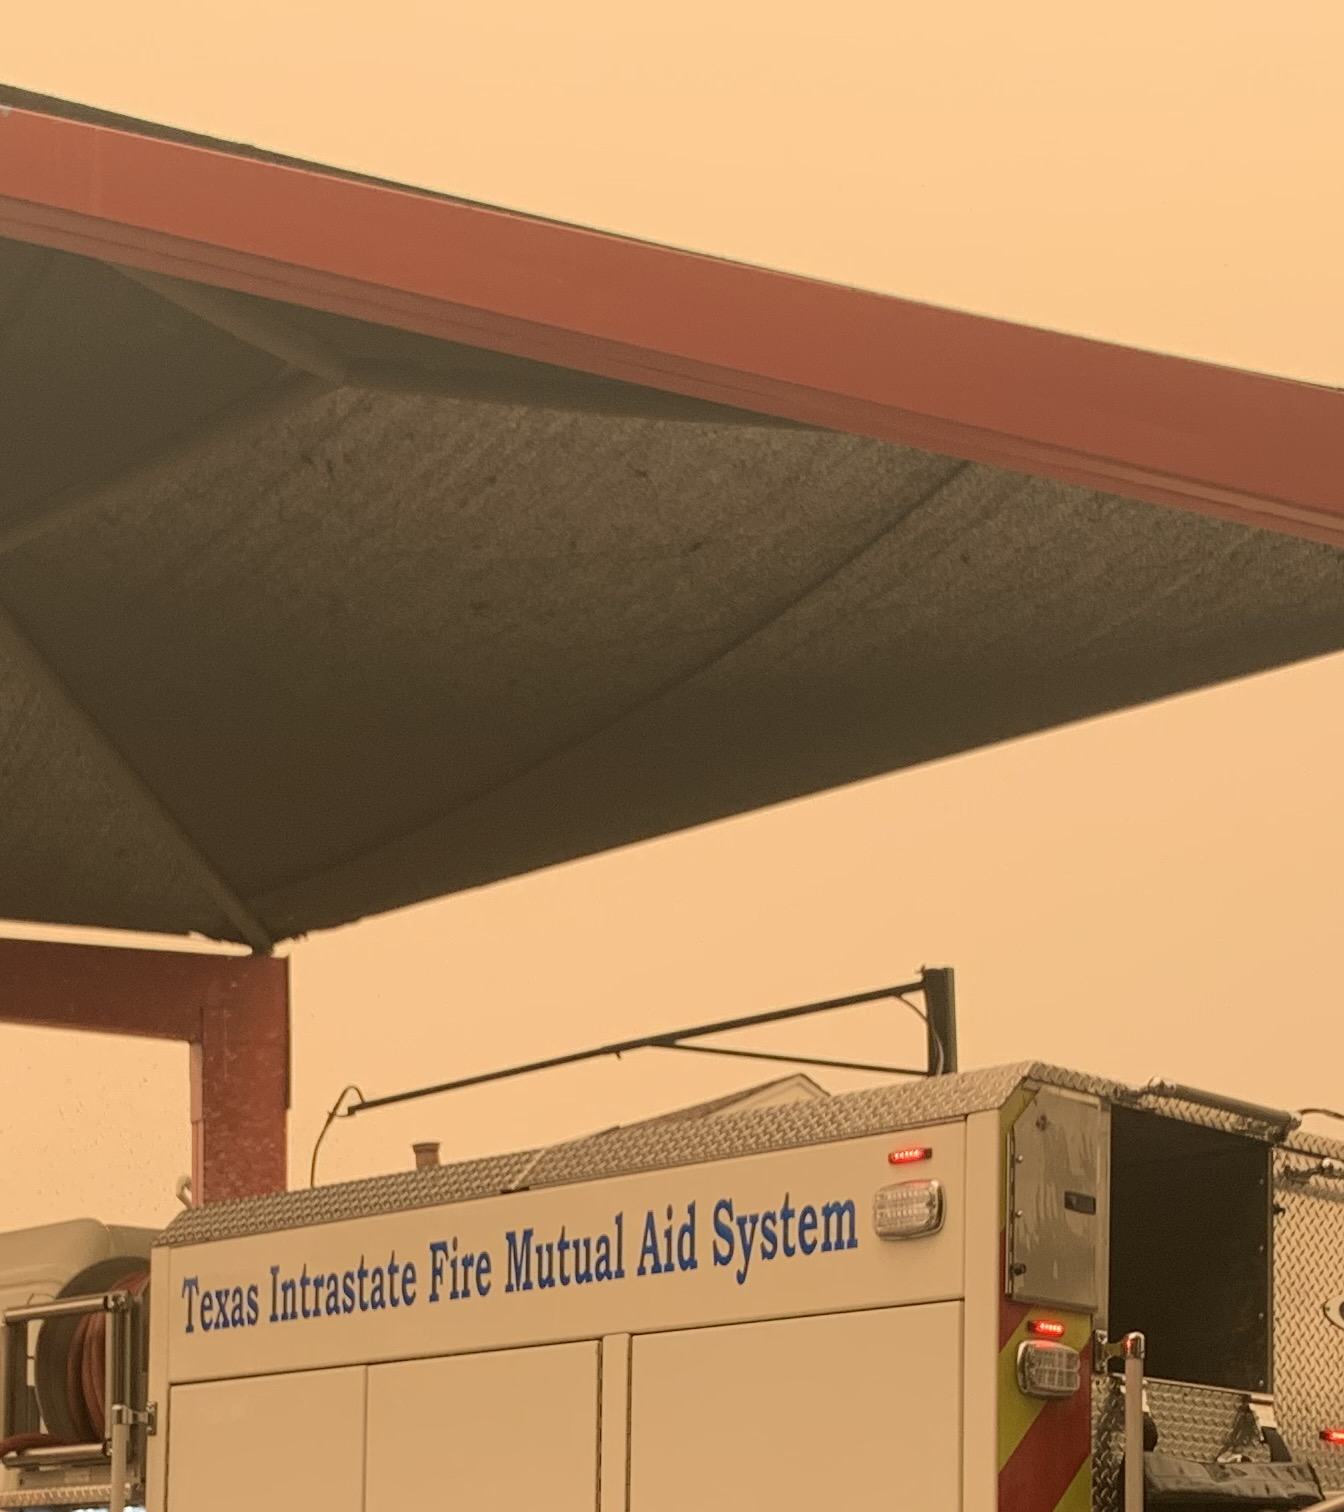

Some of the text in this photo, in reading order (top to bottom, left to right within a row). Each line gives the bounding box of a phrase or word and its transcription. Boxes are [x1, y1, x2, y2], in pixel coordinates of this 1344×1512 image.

[181, 1192, 859, 1333] Texas Intrastate Fire Mutual Aid System
